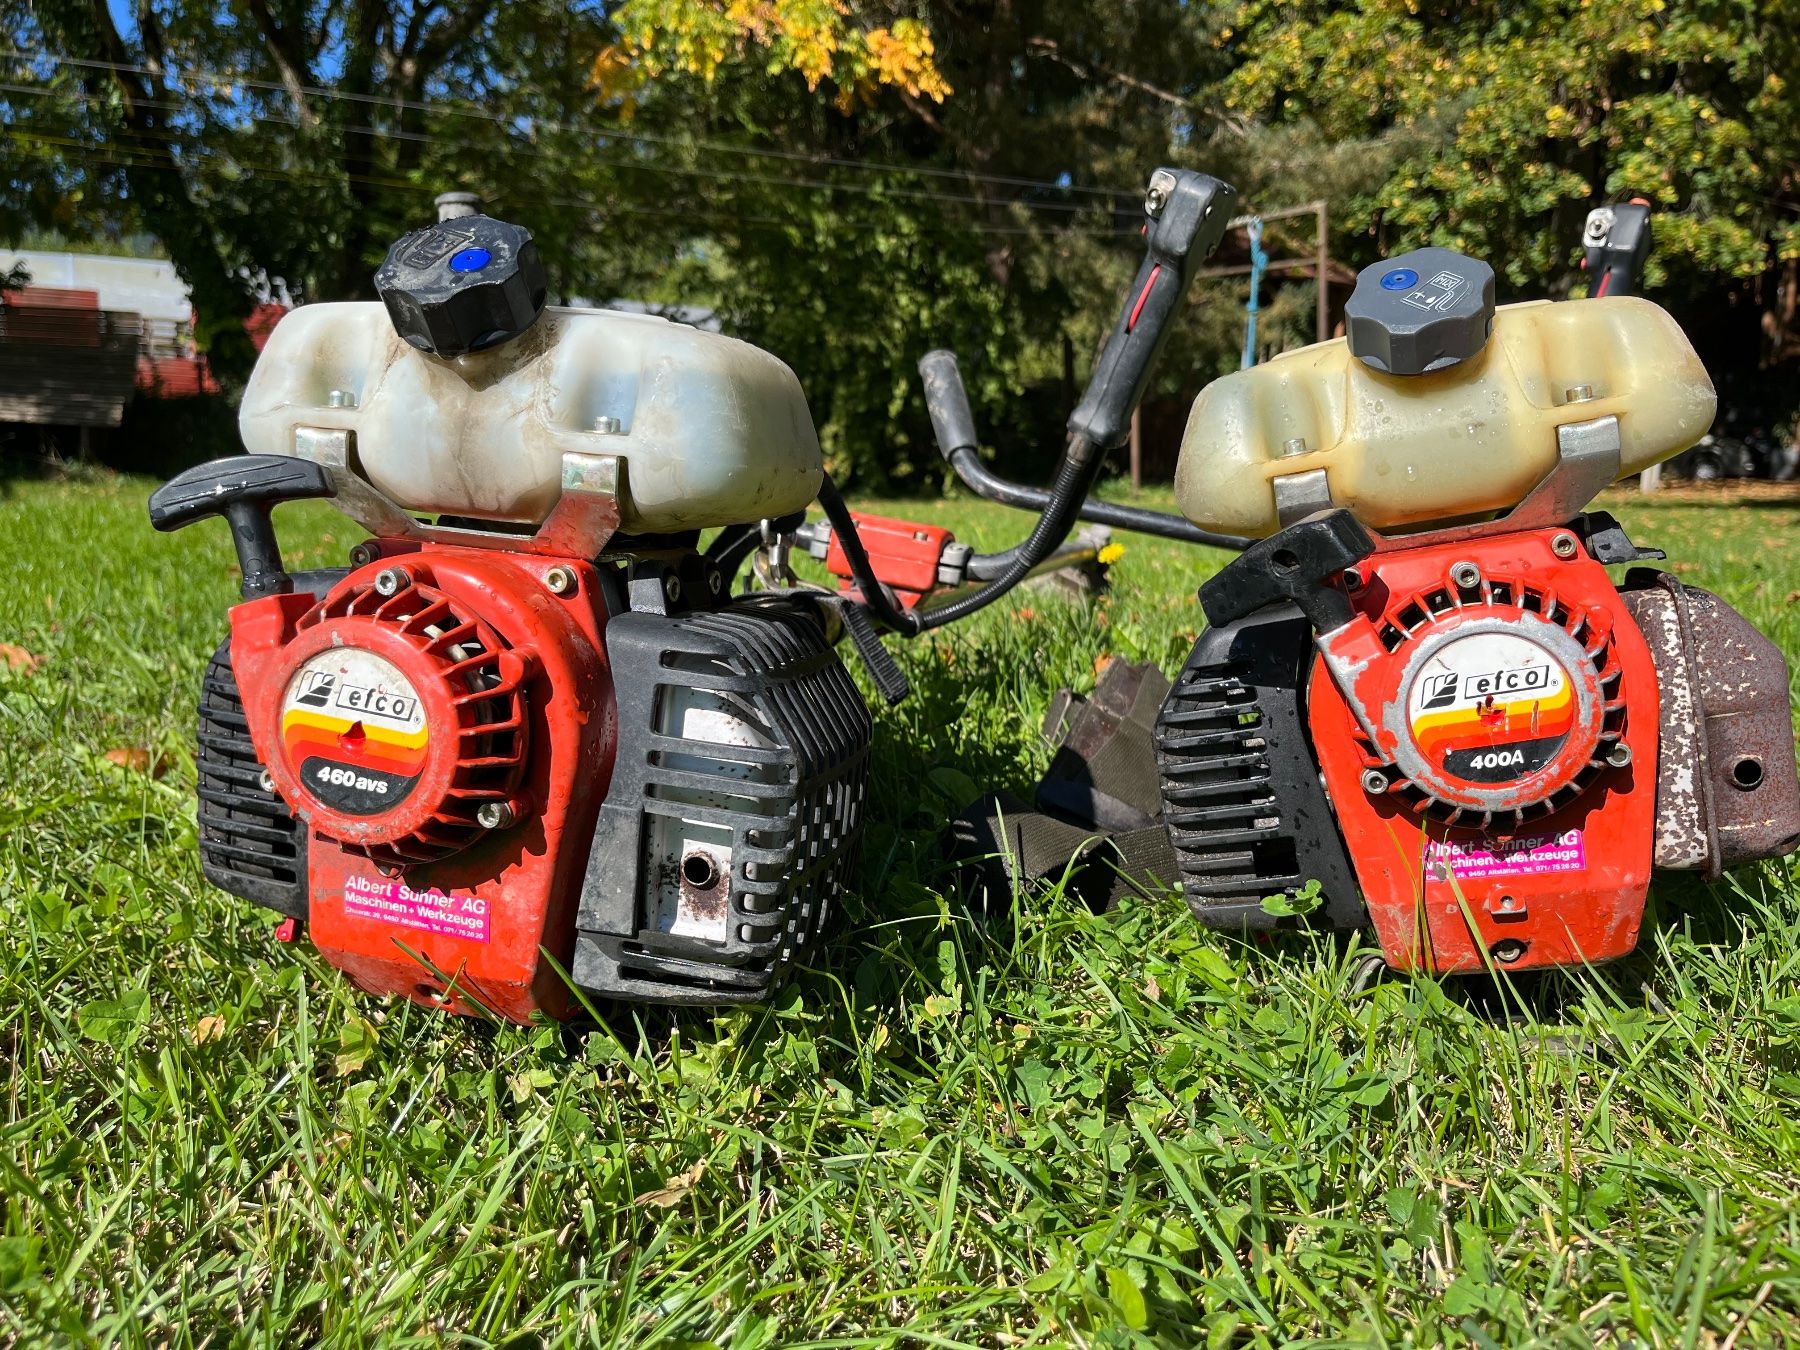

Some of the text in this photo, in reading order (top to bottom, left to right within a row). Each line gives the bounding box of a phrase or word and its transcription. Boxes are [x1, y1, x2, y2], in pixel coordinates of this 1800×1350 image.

[1436, 276, 1456, 288] MIX
[1477, 670, 1539, 693] efco
[349, 688, 405, 715] efco
[1470, 750, 1524, 769] 400A
[317, 766, 388, 794] 460avs
[1553, 830, 1578, 847] AG
[1504, 849, 1578, 865] Werkzeuge
[345, 875, 392, 897] Albert
[461, 897, 485, 914] AG
[345, 890, 407, 914] Maschinen
[417, 905, 484, 929] Werkzeuge
